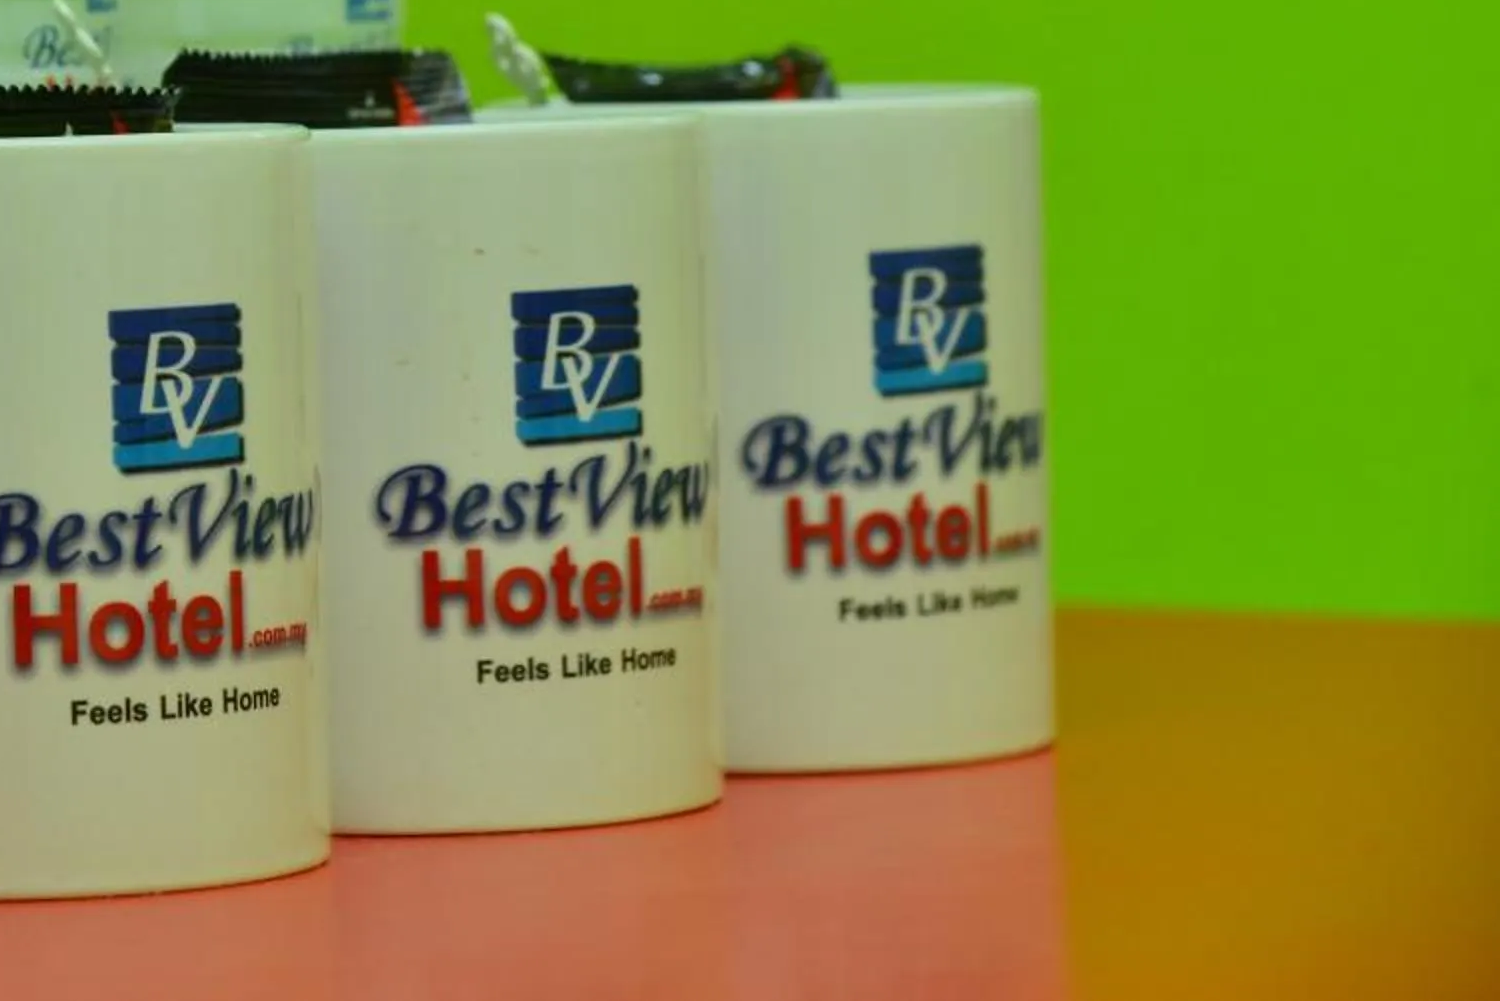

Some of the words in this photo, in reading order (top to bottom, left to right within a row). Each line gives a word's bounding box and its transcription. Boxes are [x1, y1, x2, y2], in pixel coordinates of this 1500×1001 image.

[839, 596, 906, 621] Feels
[916, 592, 962, 615] Like
[970, 585, 1019, 609] Home
[477, 656, 550, 685] Feels
[561, 652, 612, 679] Like
[621, 645, 677, 673] Home
[71, 696, 148, 726] Feels
[159, 692, 213, 720] Like
[222, 685, 281, 713] Home
